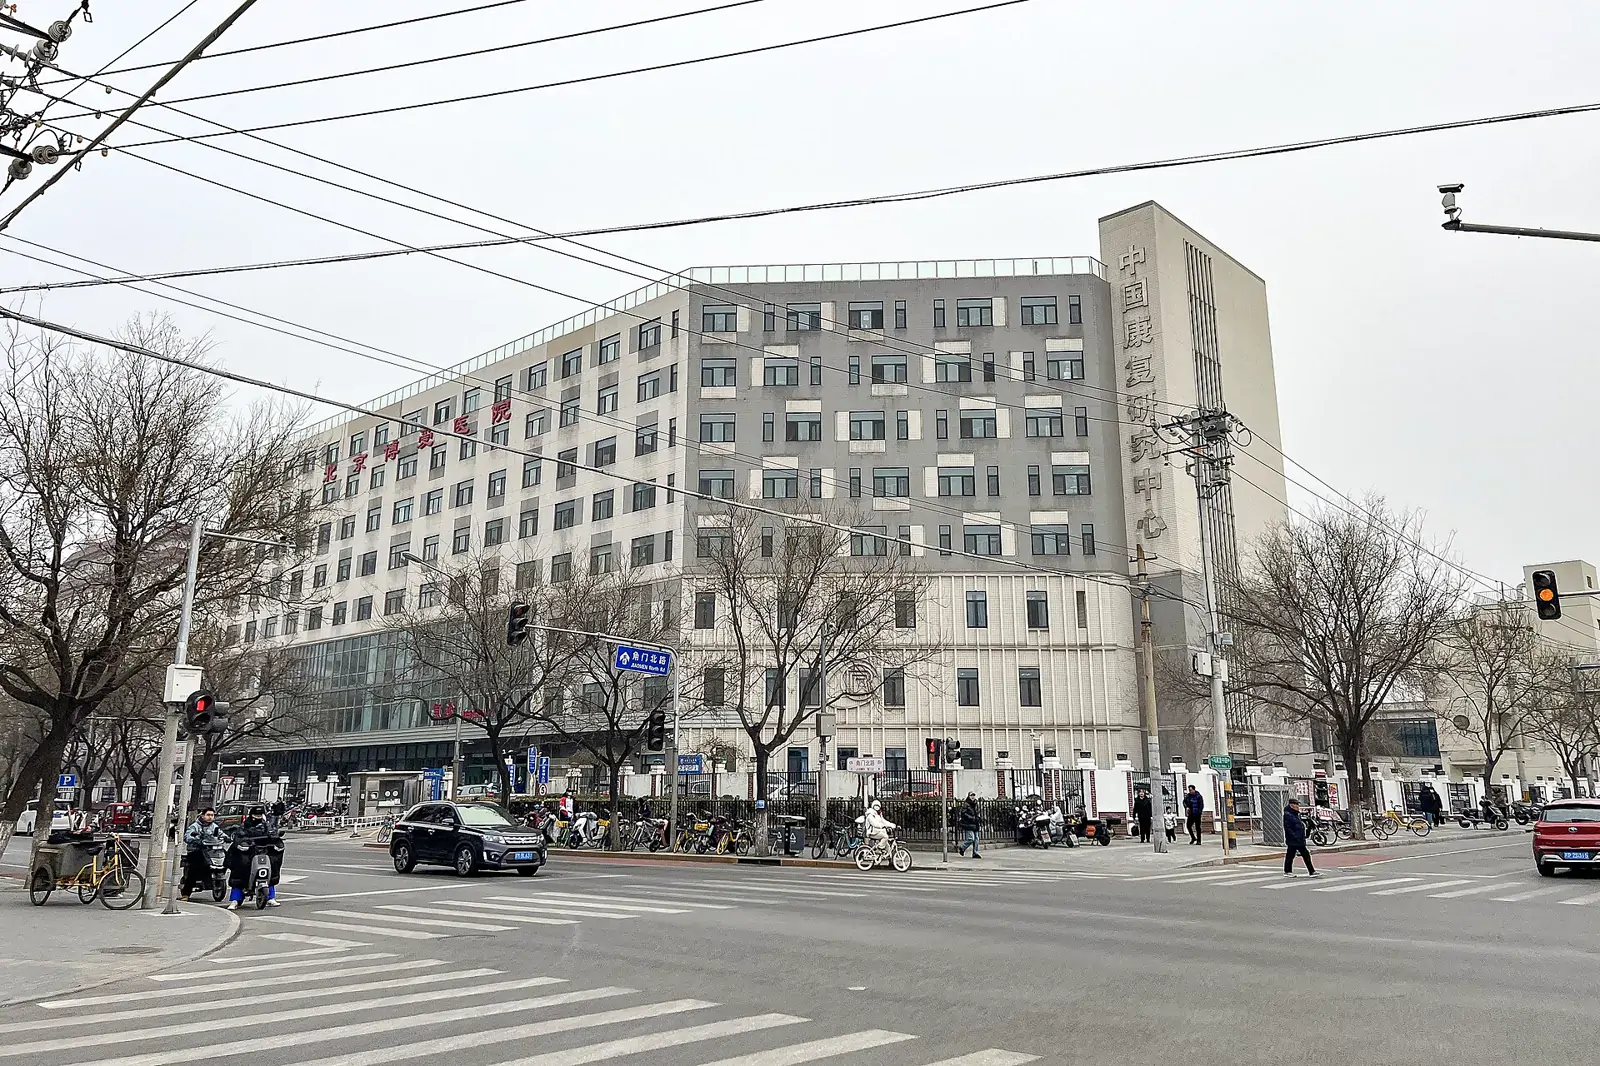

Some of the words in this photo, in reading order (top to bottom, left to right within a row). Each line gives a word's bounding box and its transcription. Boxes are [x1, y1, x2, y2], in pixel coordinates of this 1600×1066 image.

[1119, 244, 1167, 539] 中国康复研究中心
[323, 400, 511, 483] 北京博爱医院
[632, 651, 666, 665] 角门北路
[64, 776, 71, 786] P
